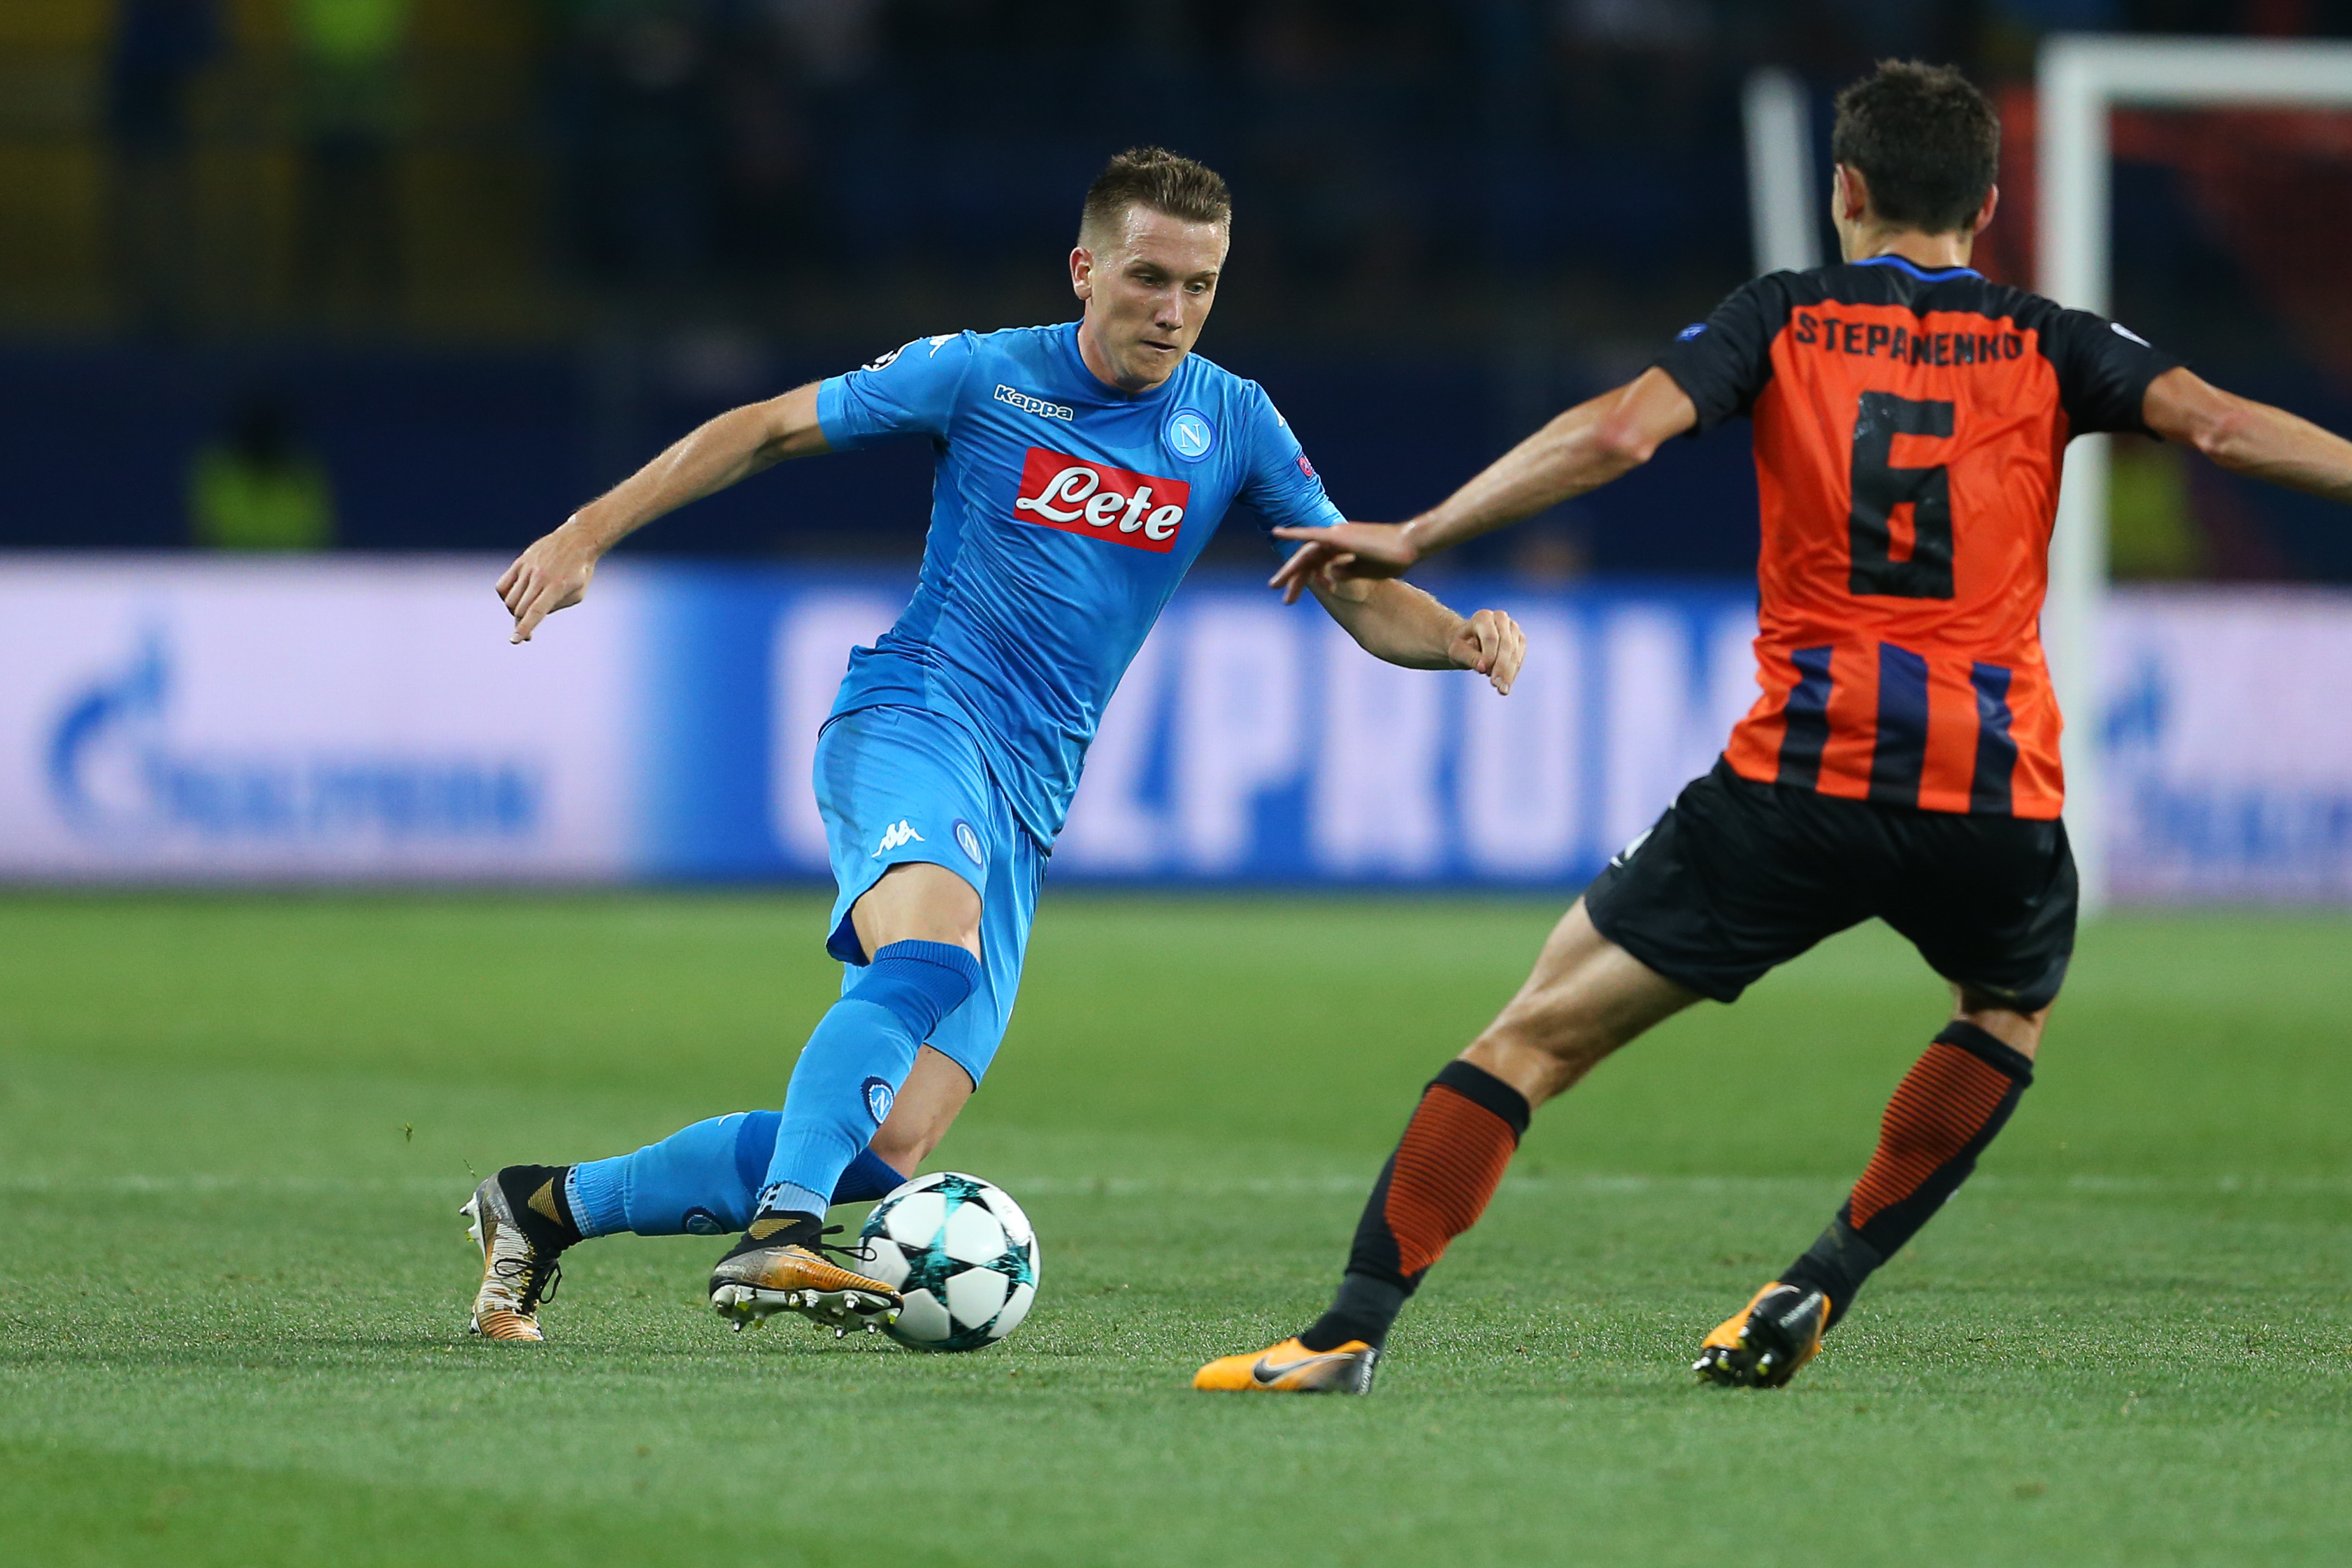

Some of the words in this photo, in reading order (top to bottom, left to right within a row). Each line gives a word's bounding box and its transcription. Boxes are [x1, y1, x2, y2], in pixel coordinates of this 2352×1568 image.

[1795, 312, 2023, 367] STEPANENKO
[994, 384, 1074, 422] Kappa
[1177, 423, 1202, 448] N
[1015, 466, 1184, 541] Lete
[1849, 390, 1955, 600] 6
[963, 828, 978, 858] N
